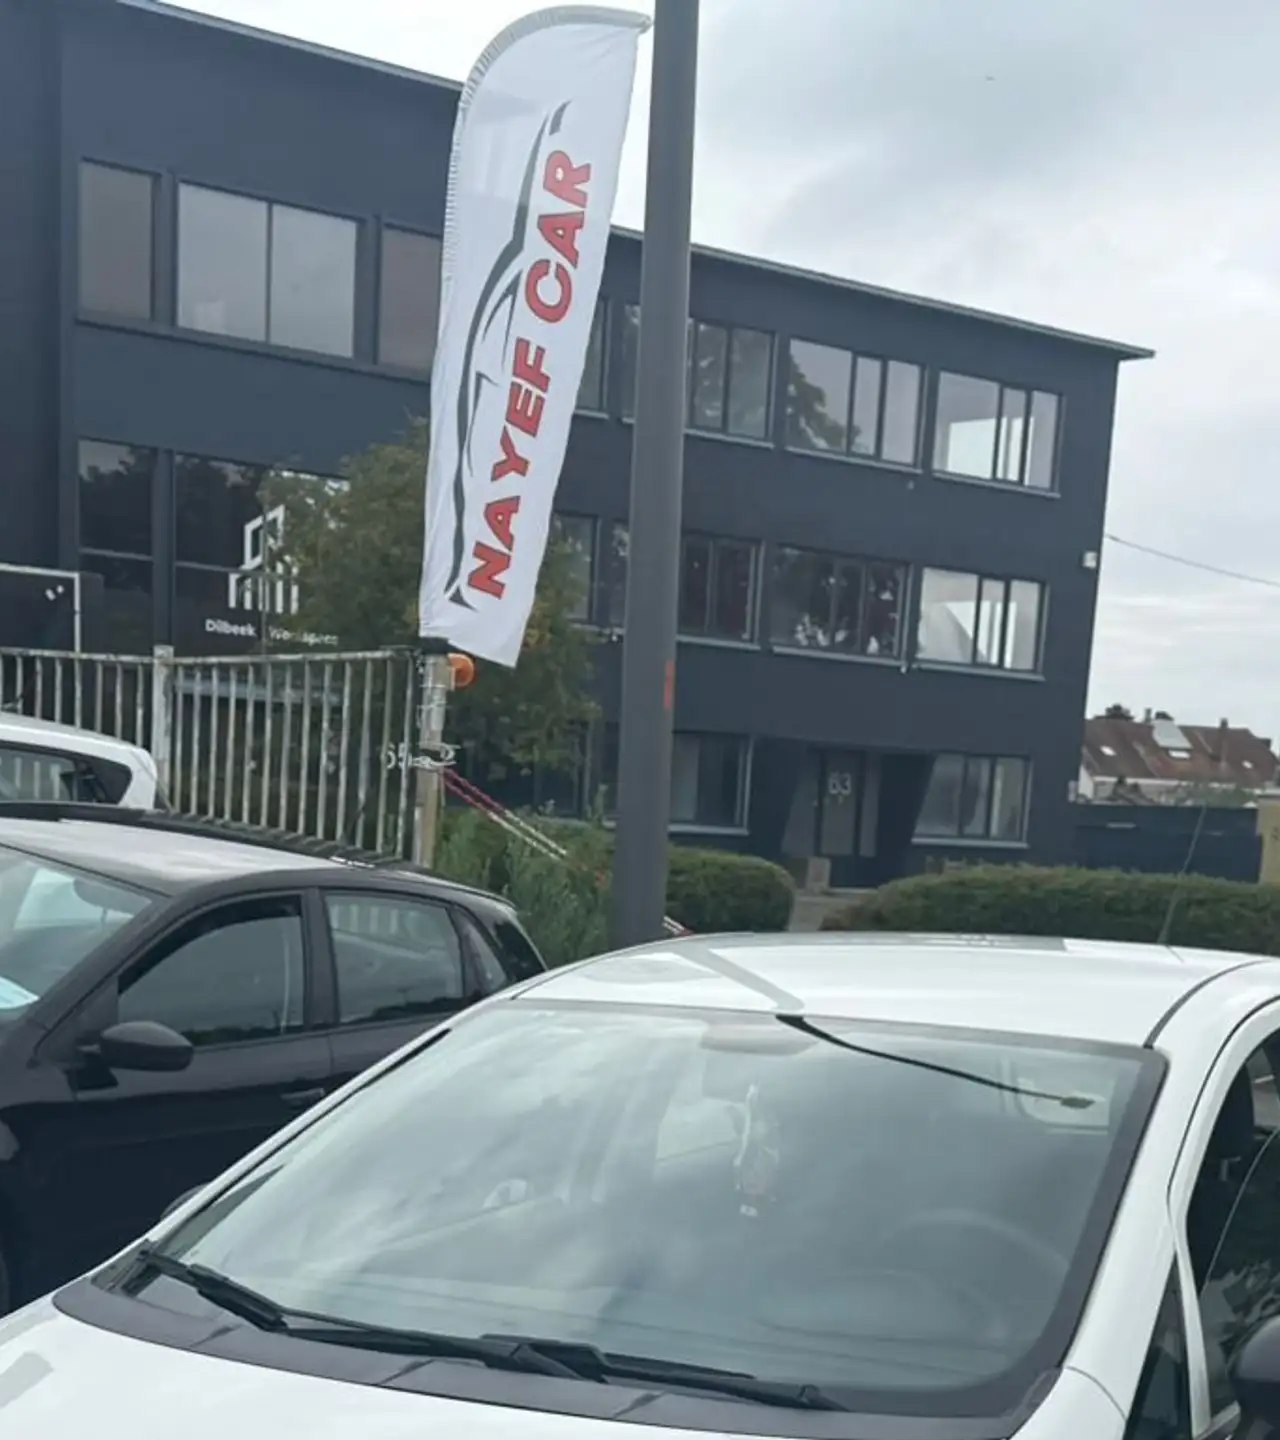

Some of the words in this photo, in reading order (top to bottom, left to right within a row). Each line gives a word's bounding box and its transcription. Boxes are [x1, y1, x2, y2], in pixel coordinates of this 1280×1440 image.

[467, 336, 552, 600] NAYEF
[524, 149, 593, 324] CAR
[205, 618, 257, 637] Dilbeek
